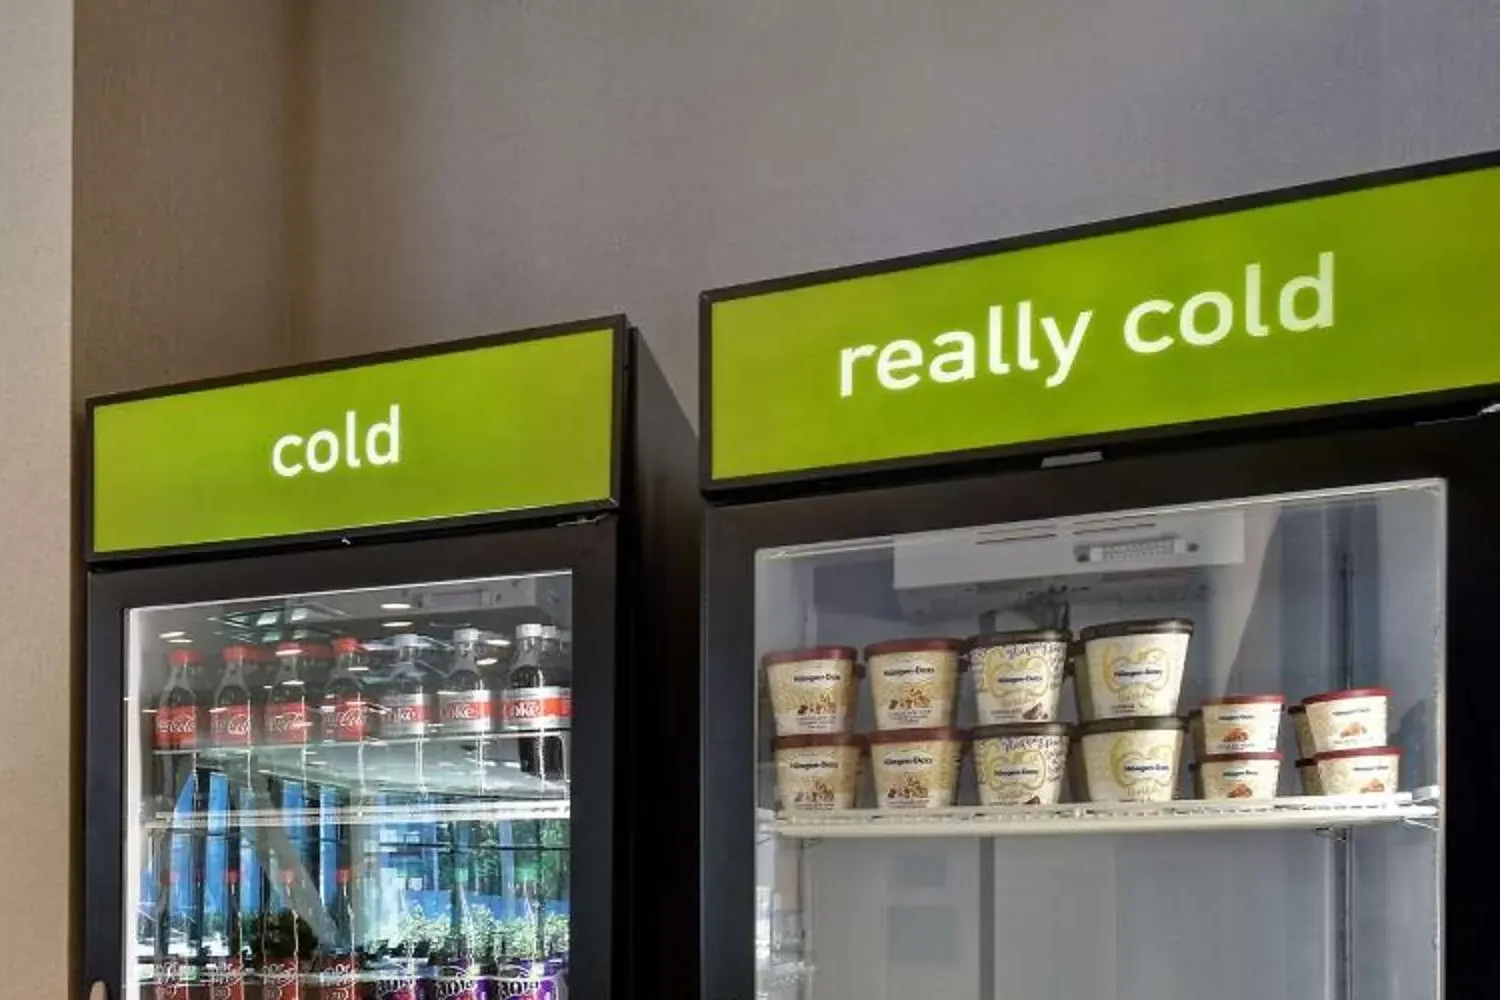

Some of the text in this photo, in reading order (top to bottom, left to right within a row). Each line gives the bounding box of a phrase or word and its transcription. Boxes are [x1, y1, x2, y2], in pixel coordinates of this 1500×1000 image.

[839, 251, 1335, 397] really cold
[272, 404, 400, 477] cold
